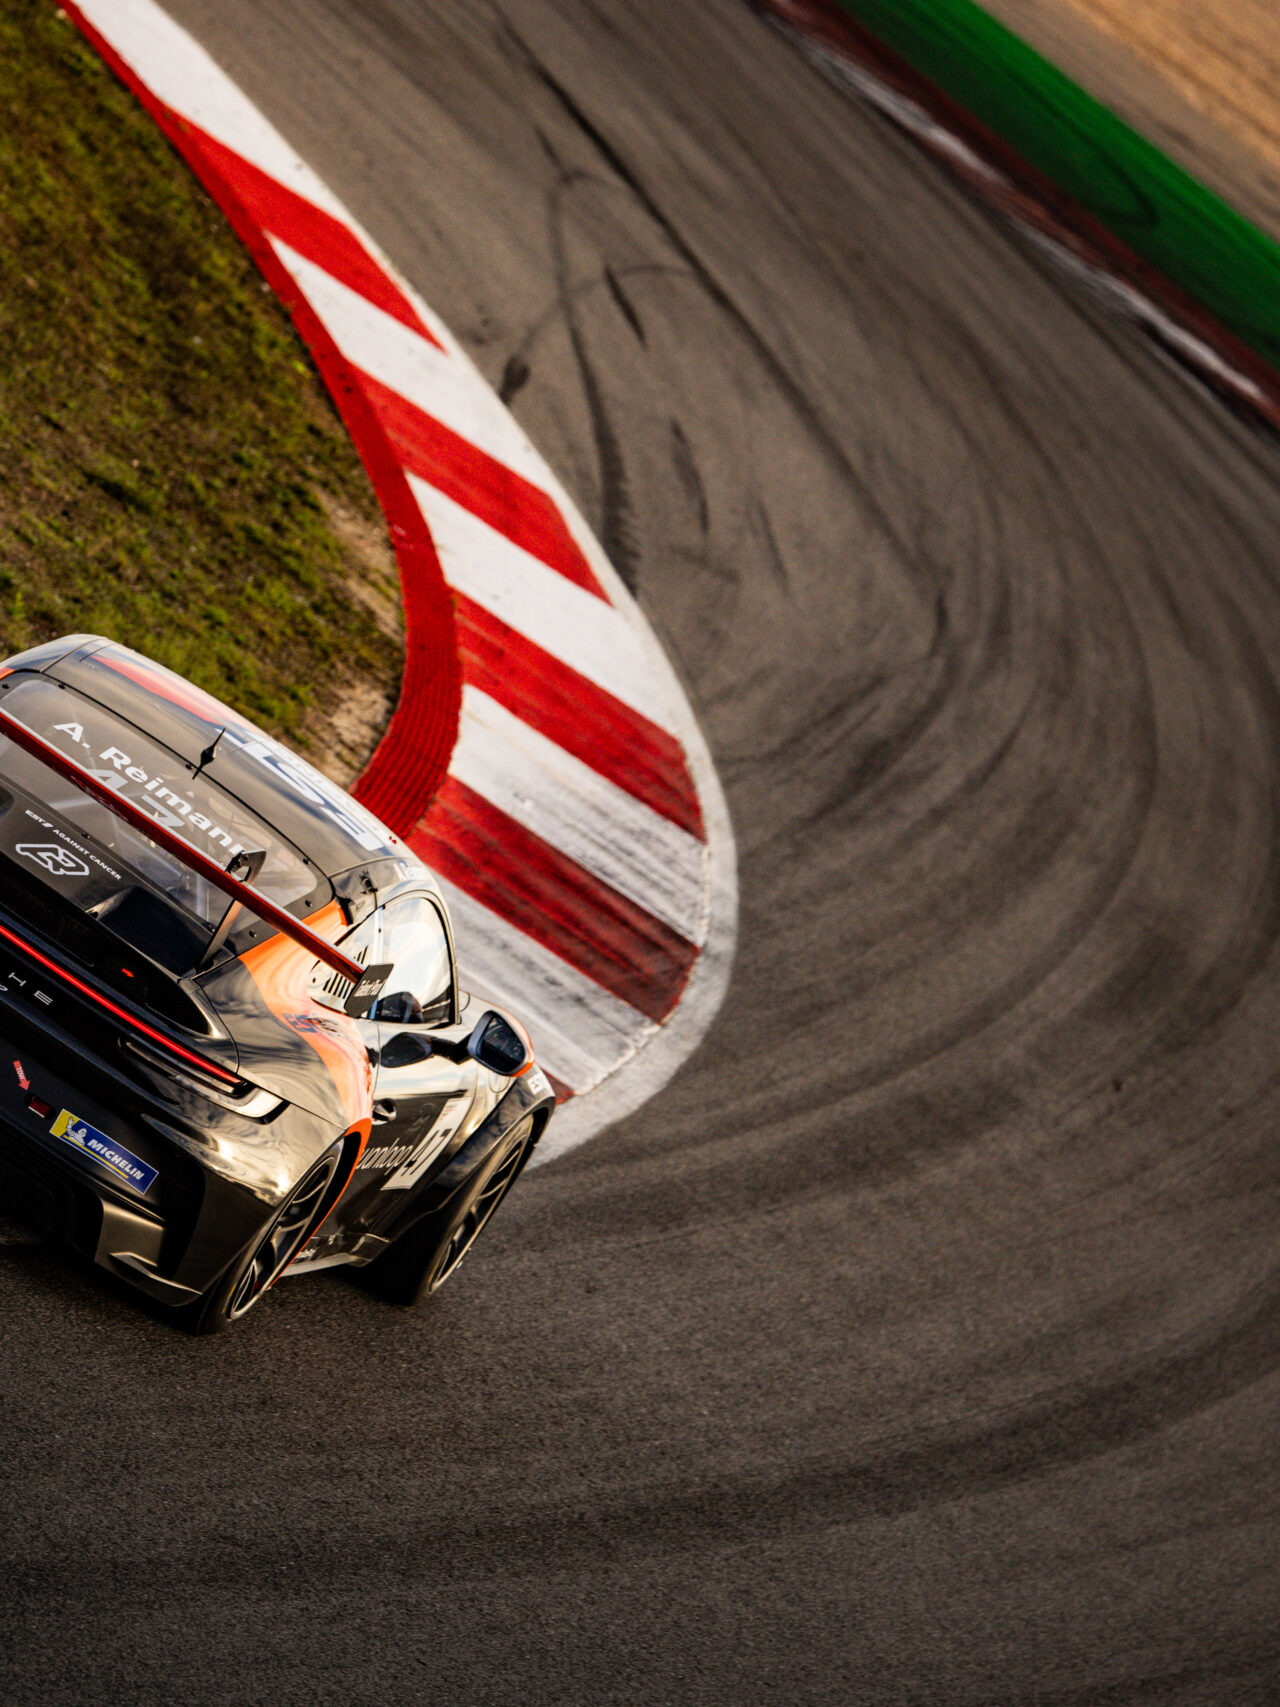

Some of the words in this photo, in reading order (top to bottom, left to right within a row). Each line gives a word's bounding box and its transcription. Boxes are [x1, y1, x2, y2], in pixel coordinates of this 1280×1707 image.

[53, 722, 91, 749] A.
[52, 829, 90, 855] AGAINST
[89, 854, 122, 881] CANCER
[87, 1138, 145, 1181] MICHELIN
[400, 1128, 453, 1177] 47
